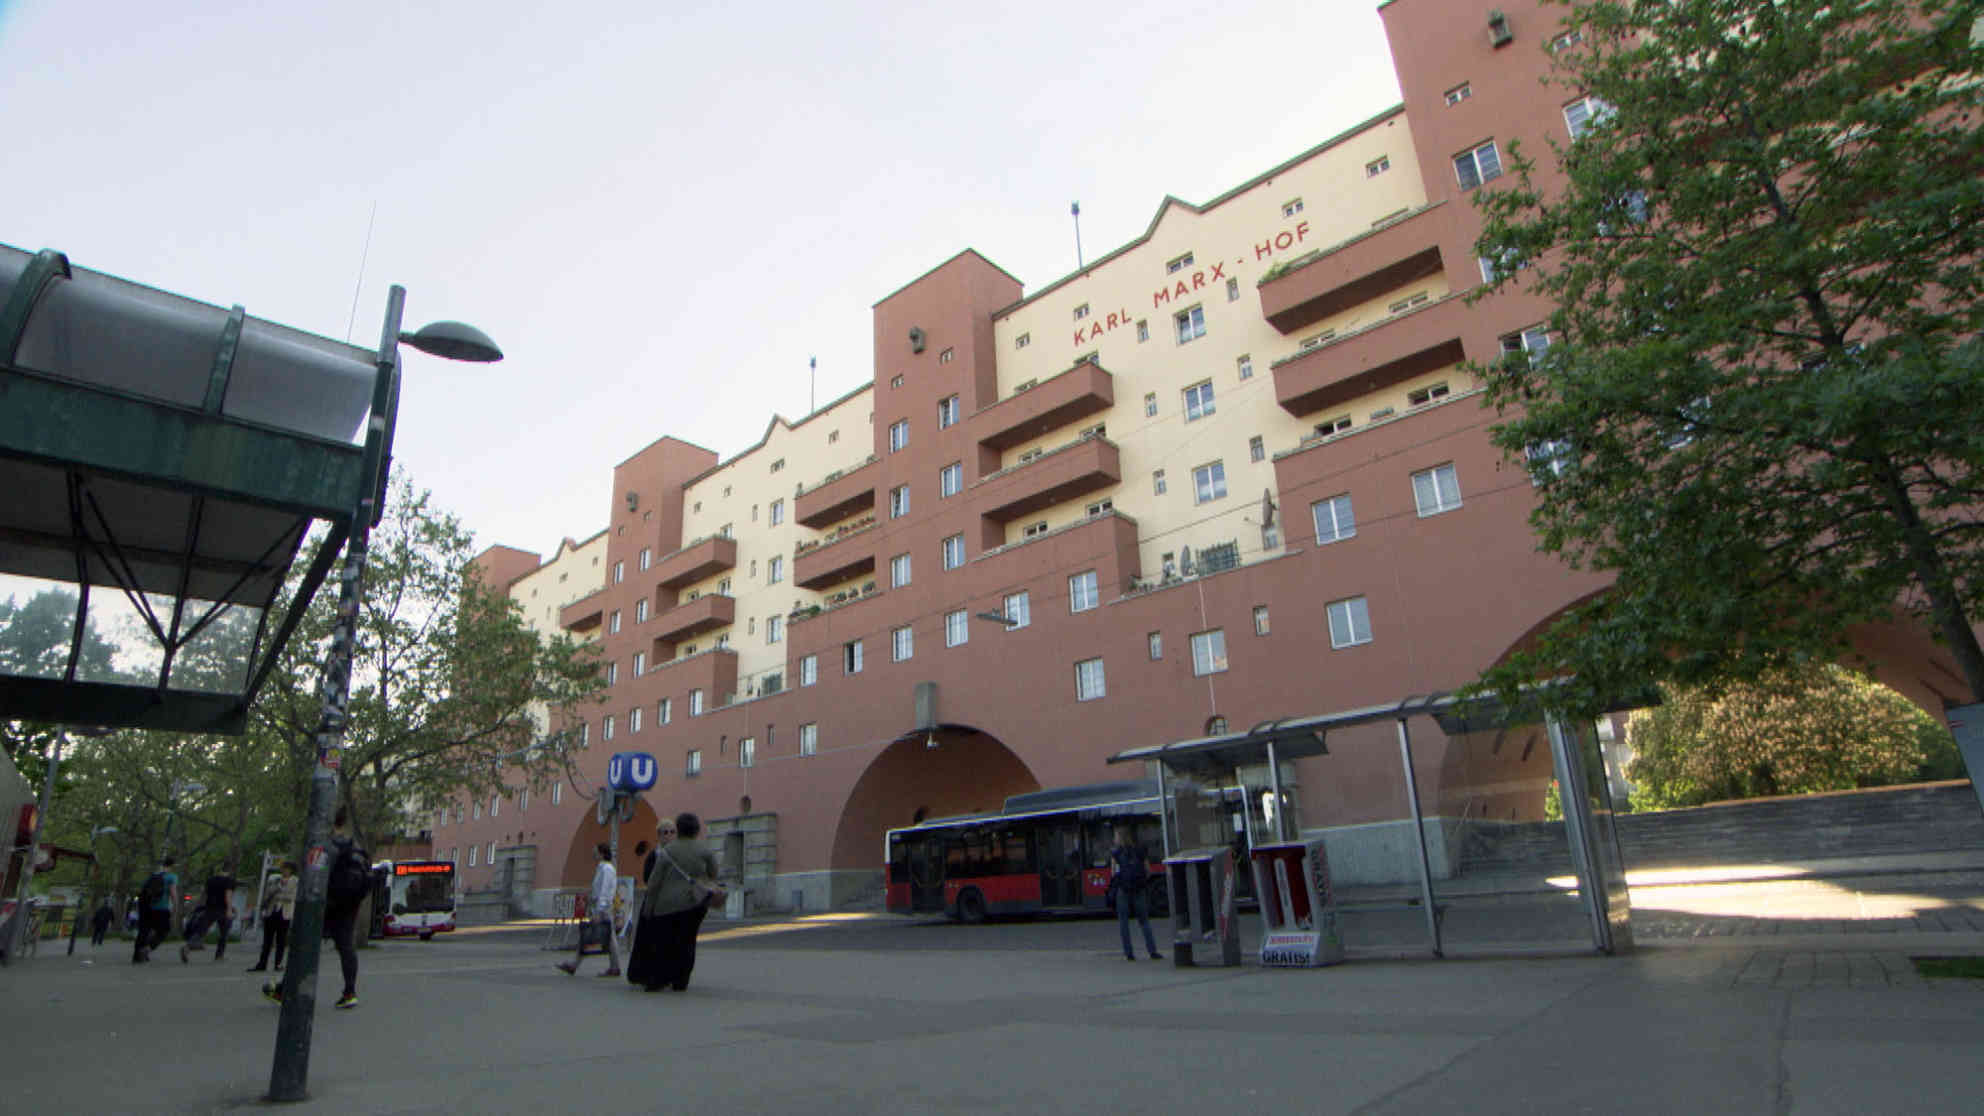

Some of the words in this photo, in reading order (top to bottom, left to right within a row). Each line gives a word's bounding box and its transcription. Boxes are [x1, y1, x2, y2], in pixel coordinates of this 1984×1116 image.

[1073, 308, 1132, 346] KARL
[1153, 262, 1226, 308] MARX
[1255, 221, 1310, 261] HOF
[610, 760, 622, 785] U
[632, 758, 653, 784] U
